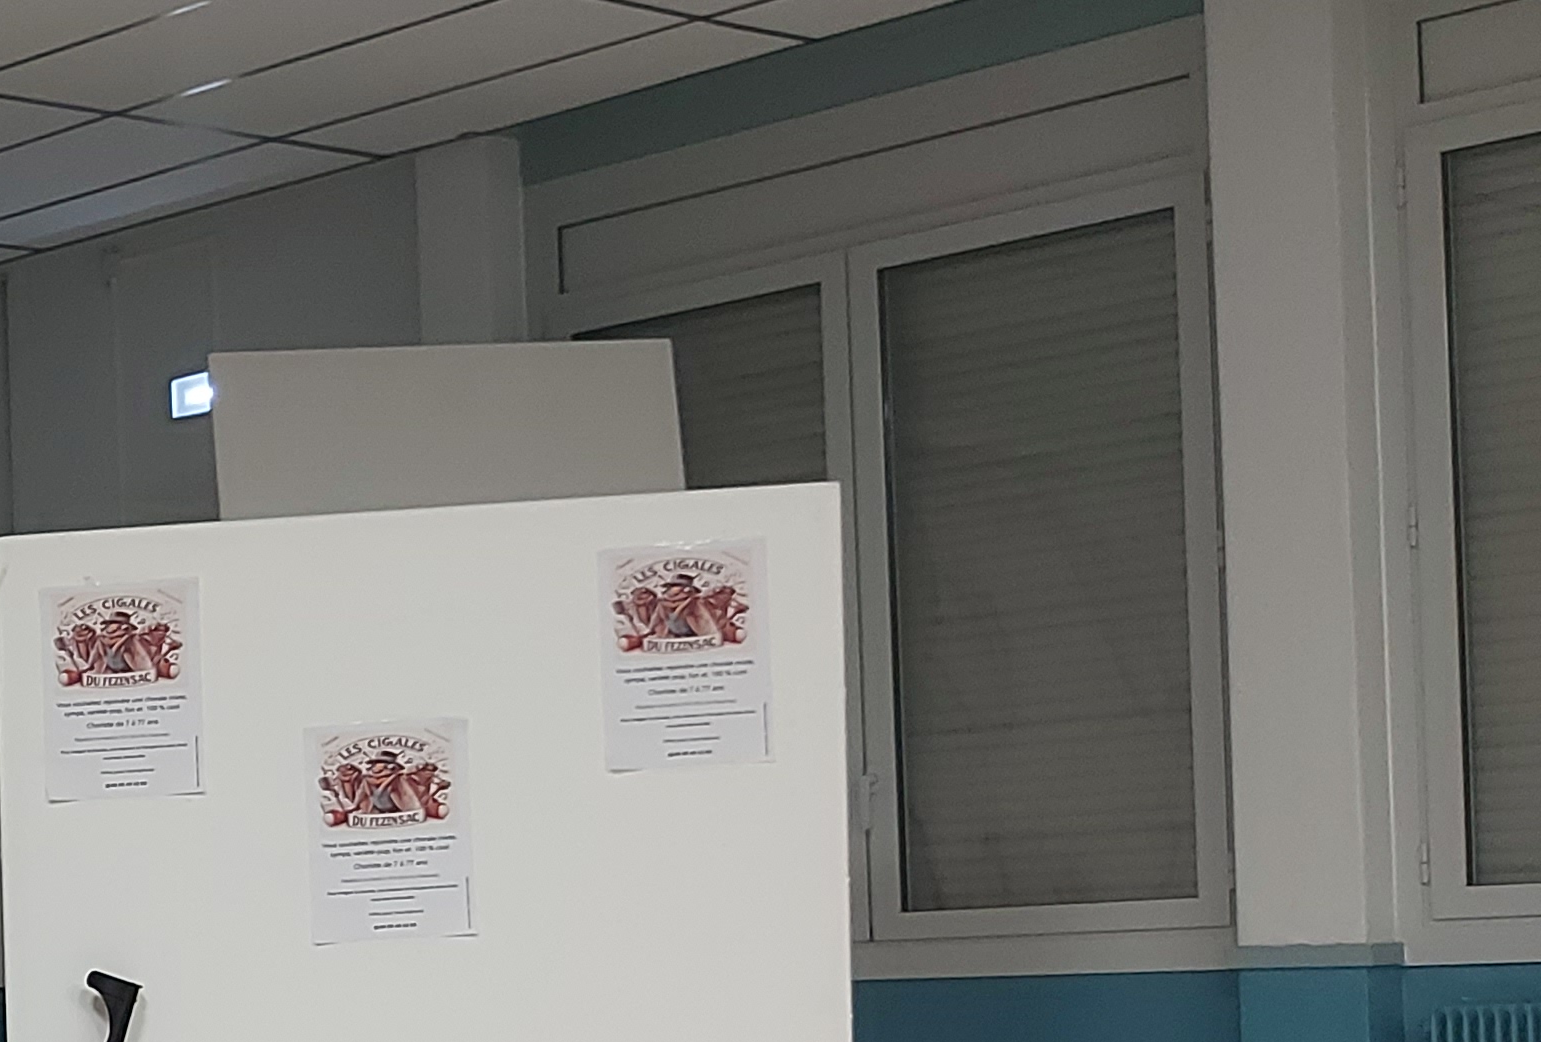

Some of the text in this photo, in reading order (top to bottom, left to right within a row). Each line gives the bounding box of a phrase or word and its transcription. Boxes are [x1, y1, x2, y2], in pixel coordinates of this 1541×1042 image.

[663, 560, 724, 575] CIGALES
[73, 598, 160, 620] LES CIGALES
[86, 675, 100, 686] DU
[338, 737, 426, 760] LES CIGALES
[352, 815, 367, 826] DU
